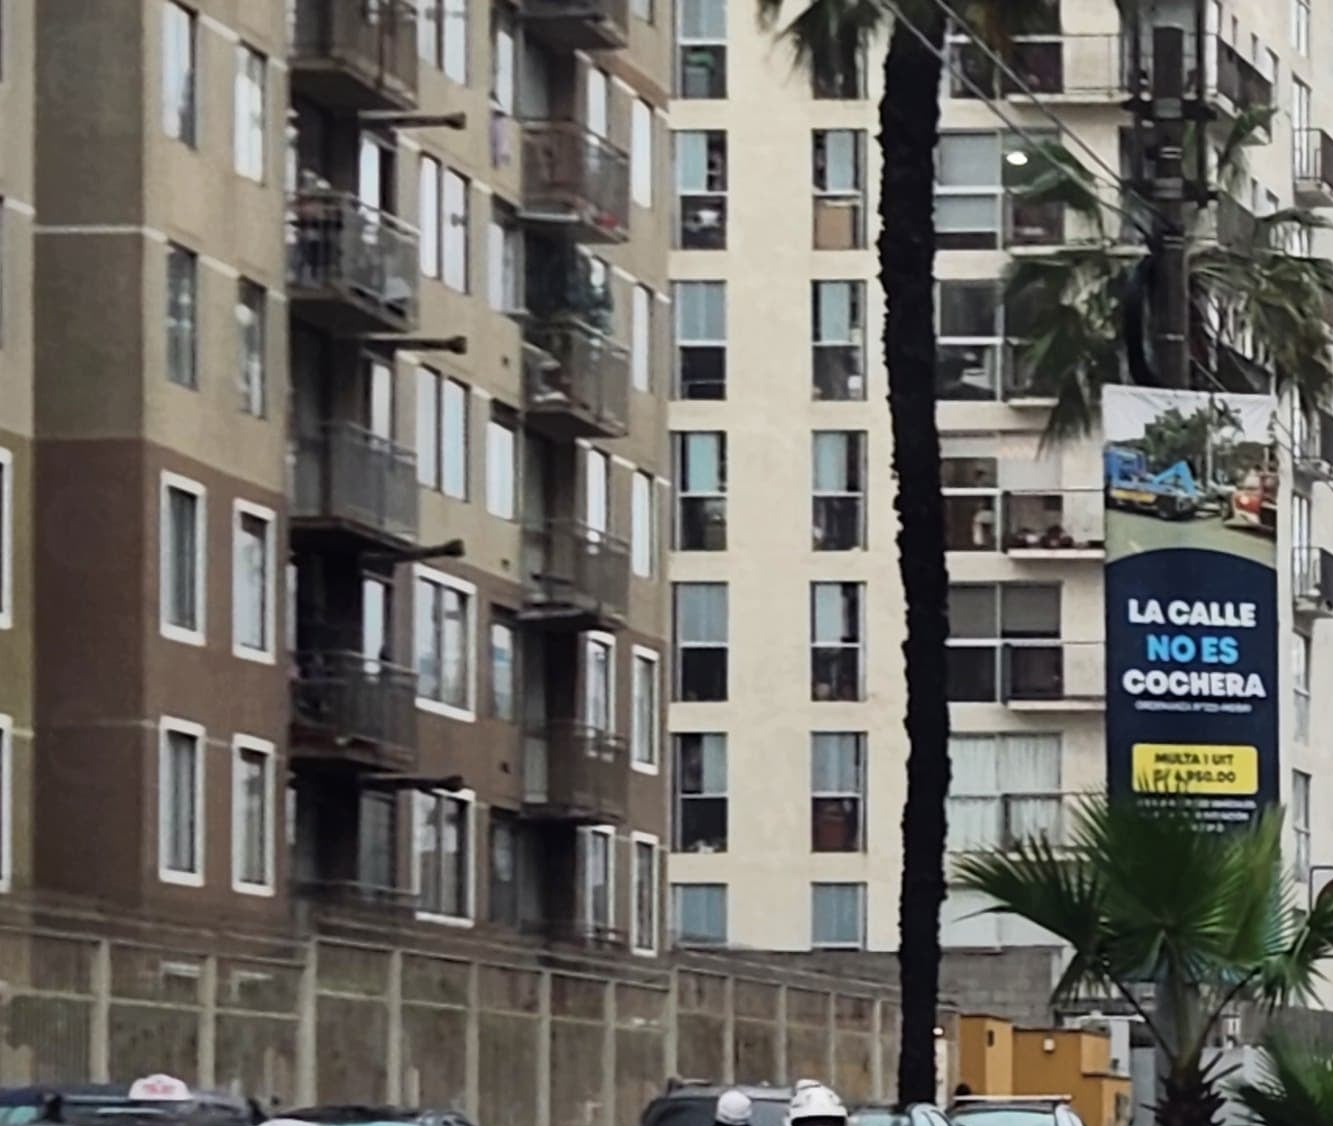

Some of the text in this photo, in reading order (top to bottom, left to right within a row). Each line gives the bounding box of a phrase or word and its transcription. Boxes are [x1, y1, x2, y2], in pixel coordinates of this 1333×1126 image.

[1128, 598, 1256, 627] LA CALLE
[1146, 634, 1239, 664] NO ES
[1122, 668, 1267, 697] COCHERA
[1154, 753, 1200, 765] MULTA
[1212, 754, 1234, 765] UIT
